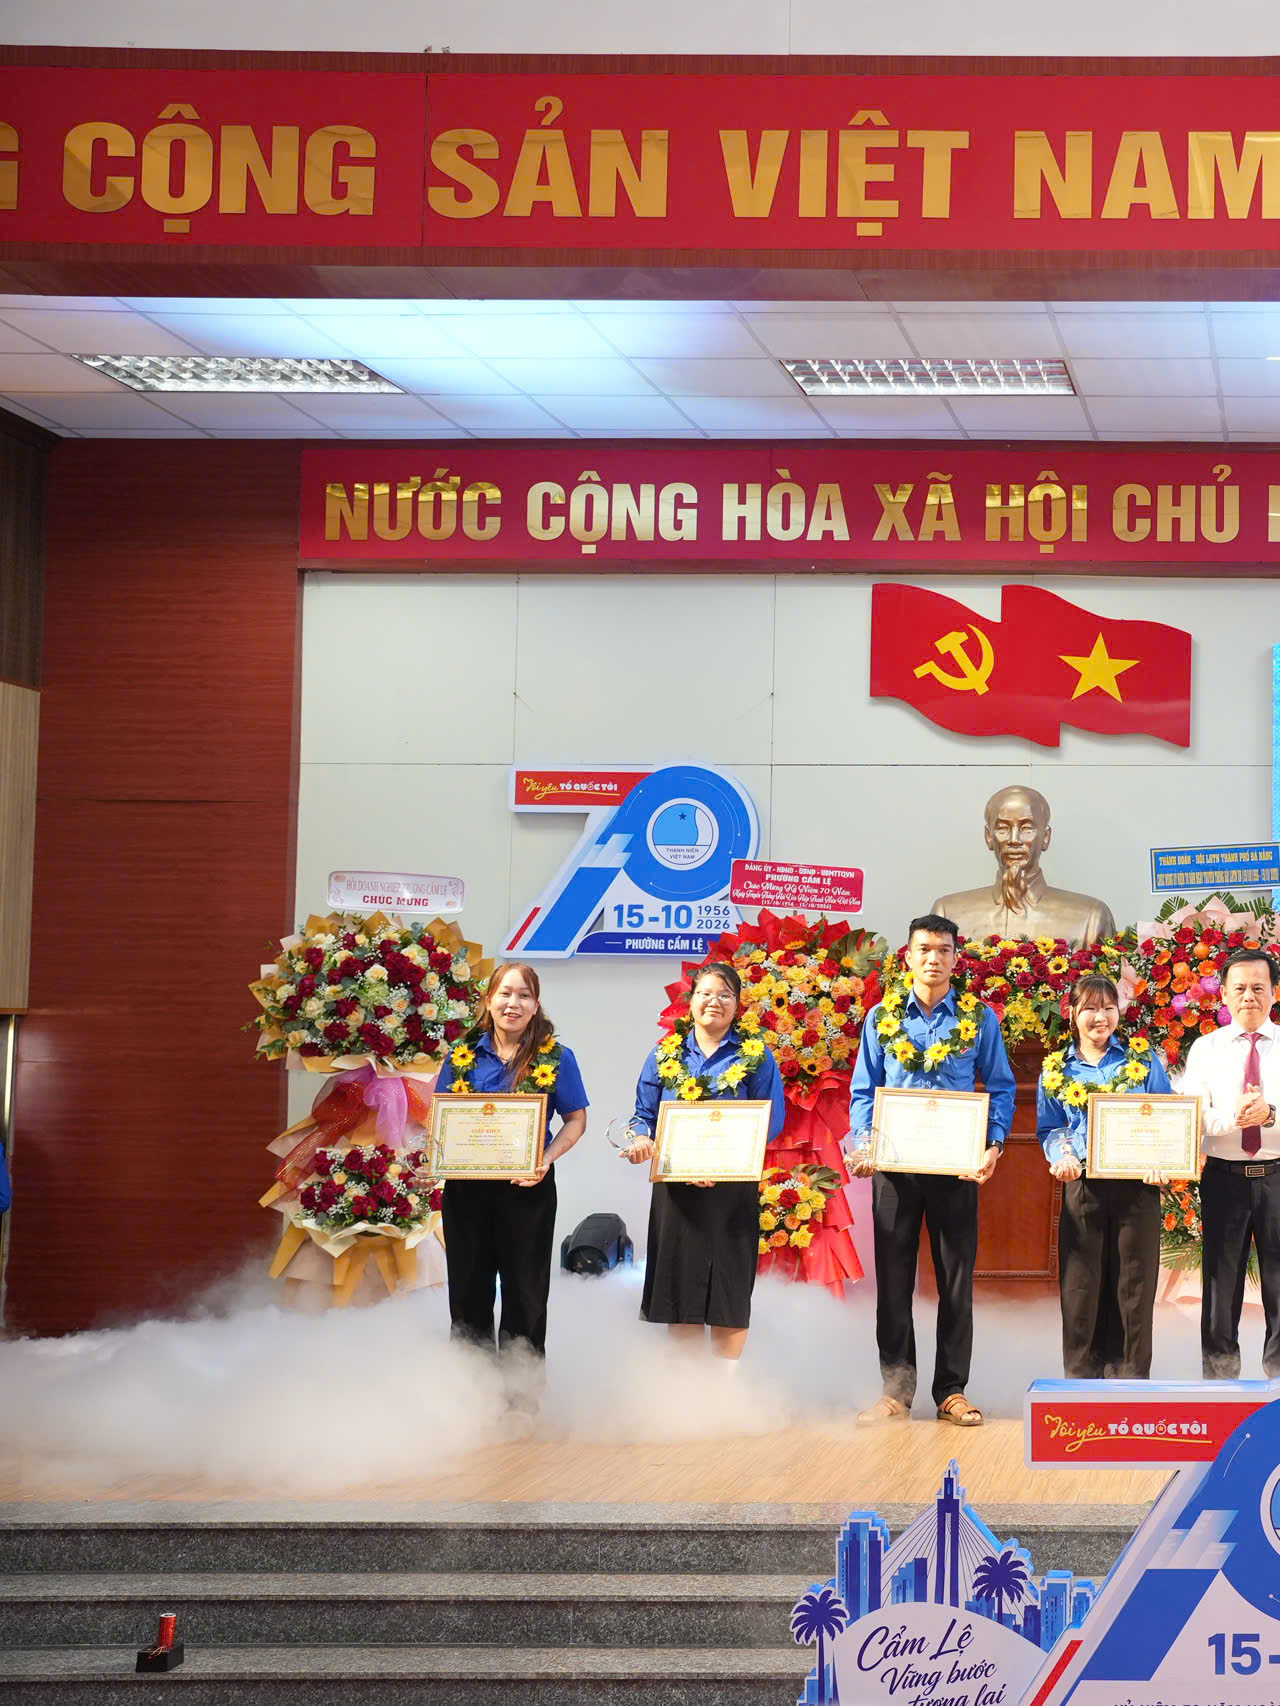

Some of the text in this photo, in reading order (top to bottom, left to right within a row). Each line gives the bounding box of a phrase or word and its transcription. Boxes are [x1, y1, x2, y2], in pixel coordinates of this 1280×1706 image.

[62, 103, 378, 232] CỘNG
[428, 96, 668, 218] SẢN
[719, 110, 969, 236] VIỆT
[325, 468, 501, 541] NƯỚC
[526, 470, 698, 554] CỘNG
[722, 468, 850, 541] HÒA
[872, 472, 961, 541] XÃ
[986, 470, 1088, 554] HỘI
[1112, 464, 1239, 543] CHỦ
[560, 780, 572, 791] TỔ
[573, 780, 600, 791] QUỐC
[601, 782, 618, 791] TÔI
[766, 873, 799, 882] PHƯỜNG
[362, 894, 392, 905] CHÚC
[697, 905, 730, 916] 1956
[697, 919, 730, 929] 2026
[625, 936, 704, 952] PHƯỜNG CẨM LỆ
[1045, 1415, 1207, 1452] Tôi yêu TỔ QUỐC TÔI
[857, 1618, 975, 1672] Cẩm Lệ
[881, 1659, 997, 1696] Vững bước
[974, 1683, 1007, 1706] lai
